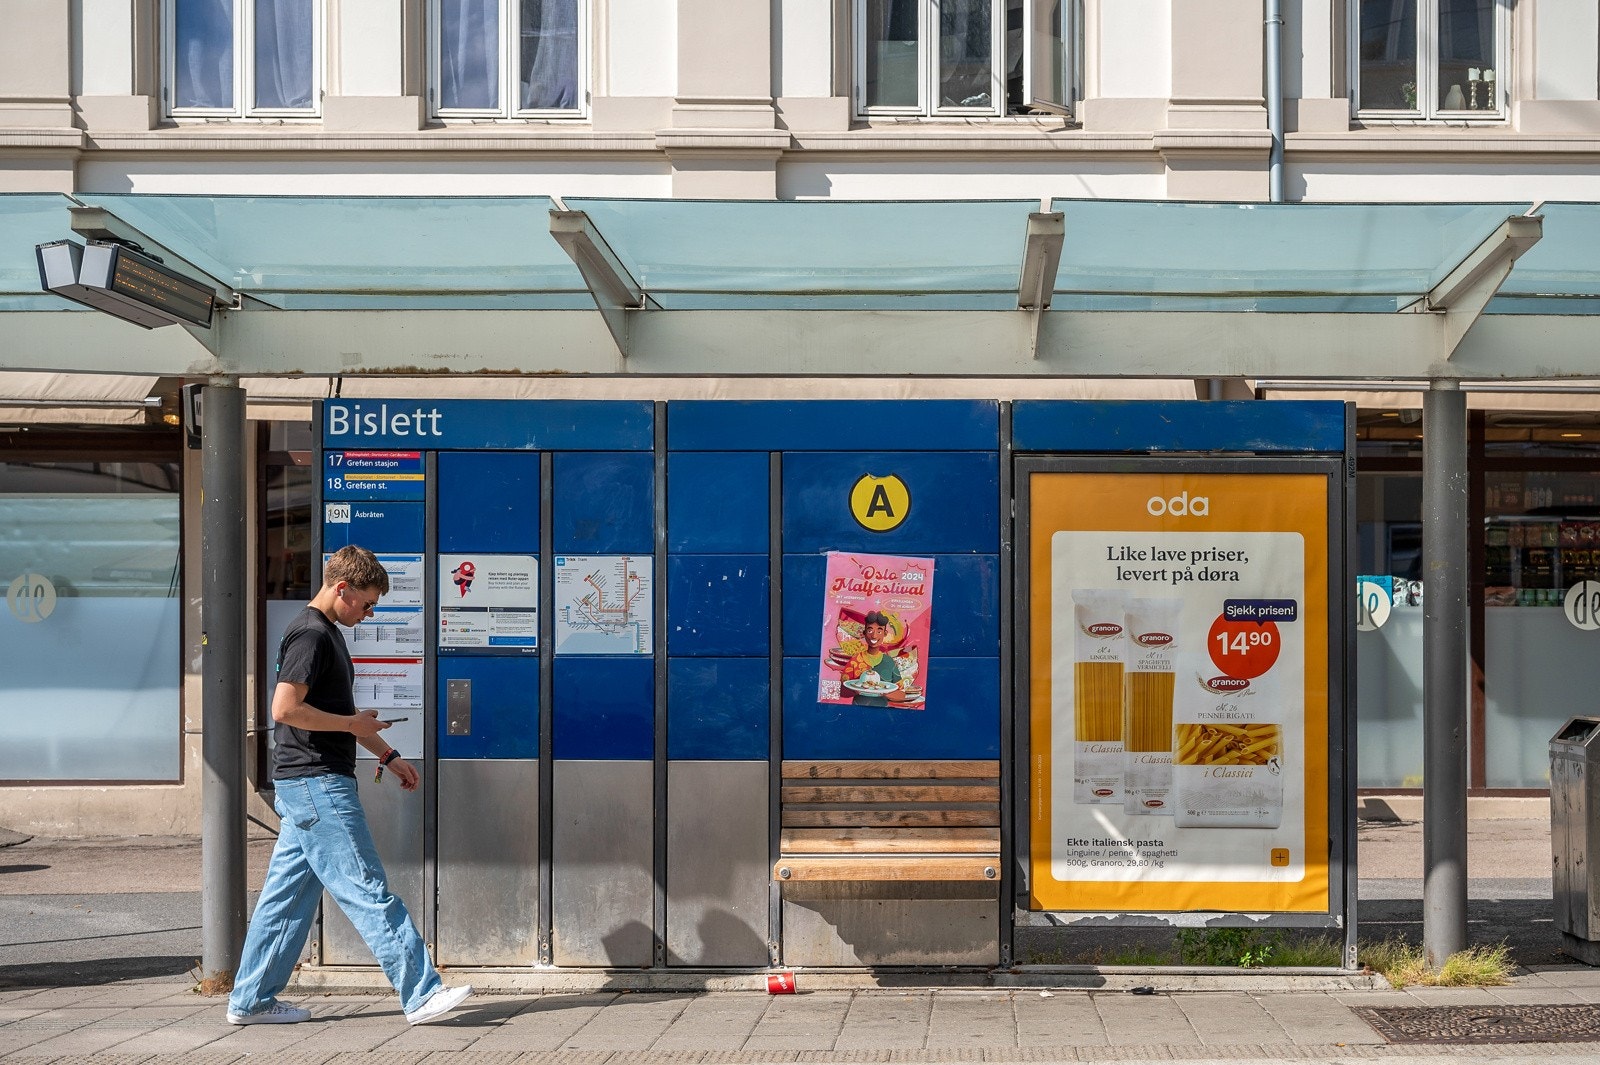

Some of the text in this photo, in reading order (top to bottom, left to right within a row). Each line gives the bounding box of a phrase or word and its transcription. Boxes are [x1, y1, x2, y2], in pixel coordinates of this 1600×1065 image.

[328, 403, 443, 436] Bislett
[328, 454, 344, 467] 17
[374, 460, 399, 468] stasjon
[327, 477, 342, 490] 18
[346, 481, 388, 490] Grefsen st.
[865, 484, 895, 518] A
[1147, 491, 1209, 516] oda
[328, 508, 349, 519] 19N
[354, 509, 385, 518] Åsbråten
[1106, 546, 1250, 565] Like lave priser,
[861, 565, 898, 581] Oslo
[901, 572, 924, 581] 2024
[1116, 566, 1240, 585] levert på døra
[1226, 605, 1294, 618] Sjekk prisen!
[1091, 625, 1119, 633] granoro
[1141, 634, 1170, 643] granoro
[1211, 679, 1246, 688] granoro
[1212, 767, 1254, 778] Classici
[1067, 838, 1164, 848] Ekte italiensk pasta
[1066, 849, 1100, 858] Linguine
[1108, 850, 1134, 858] penne
[1142, 849, 1178, 858] spaghetti
[1126, 859, 1149, 867] 29,80
[1150, 859, 1164, 868] /kg
